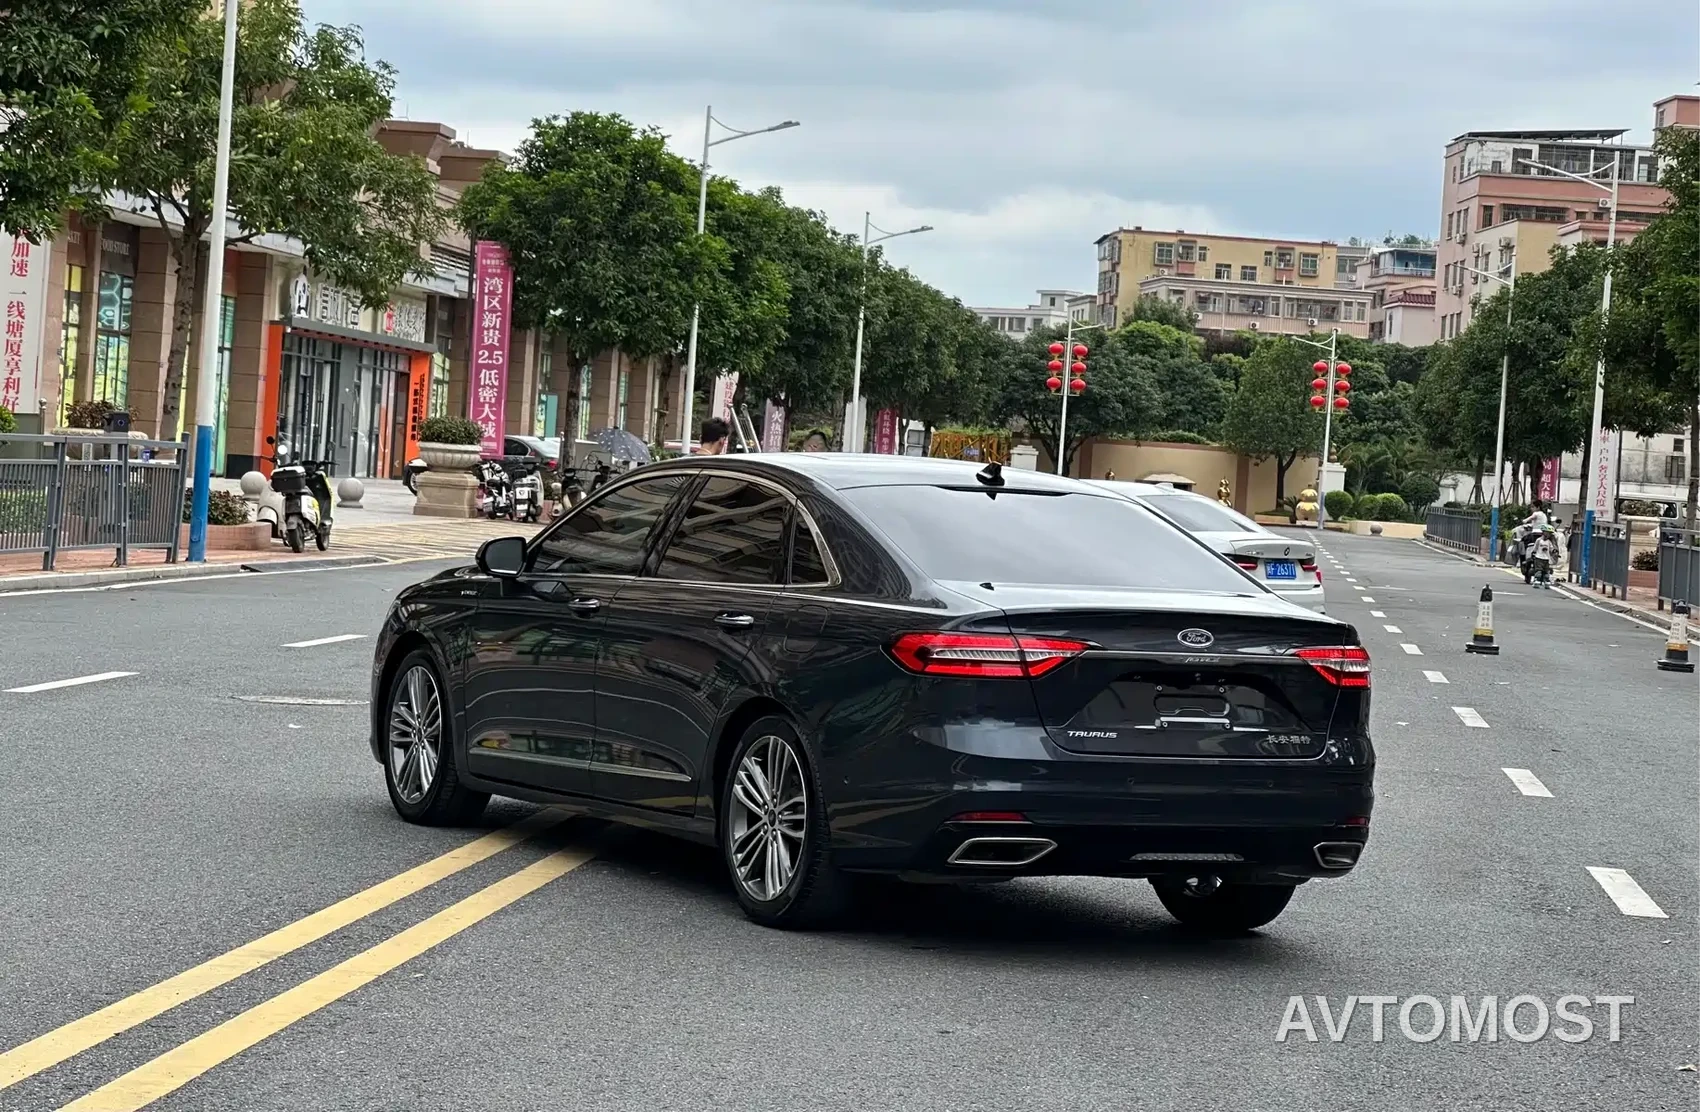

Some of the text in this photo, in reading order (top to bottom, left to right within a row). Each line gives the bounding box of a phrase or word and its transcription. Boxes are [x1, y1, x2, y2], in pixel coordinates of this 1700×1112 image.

[10, 229, 31, 278] 加速
[481, 277, 504, 347] 湾区新贵
[477, 349, 503, 365] 2.5
[769, 410, 783, 452] 火热招
[1186, 631, 1207, 643] Ford
[1067, 730, 1118, 739] TAURUS
